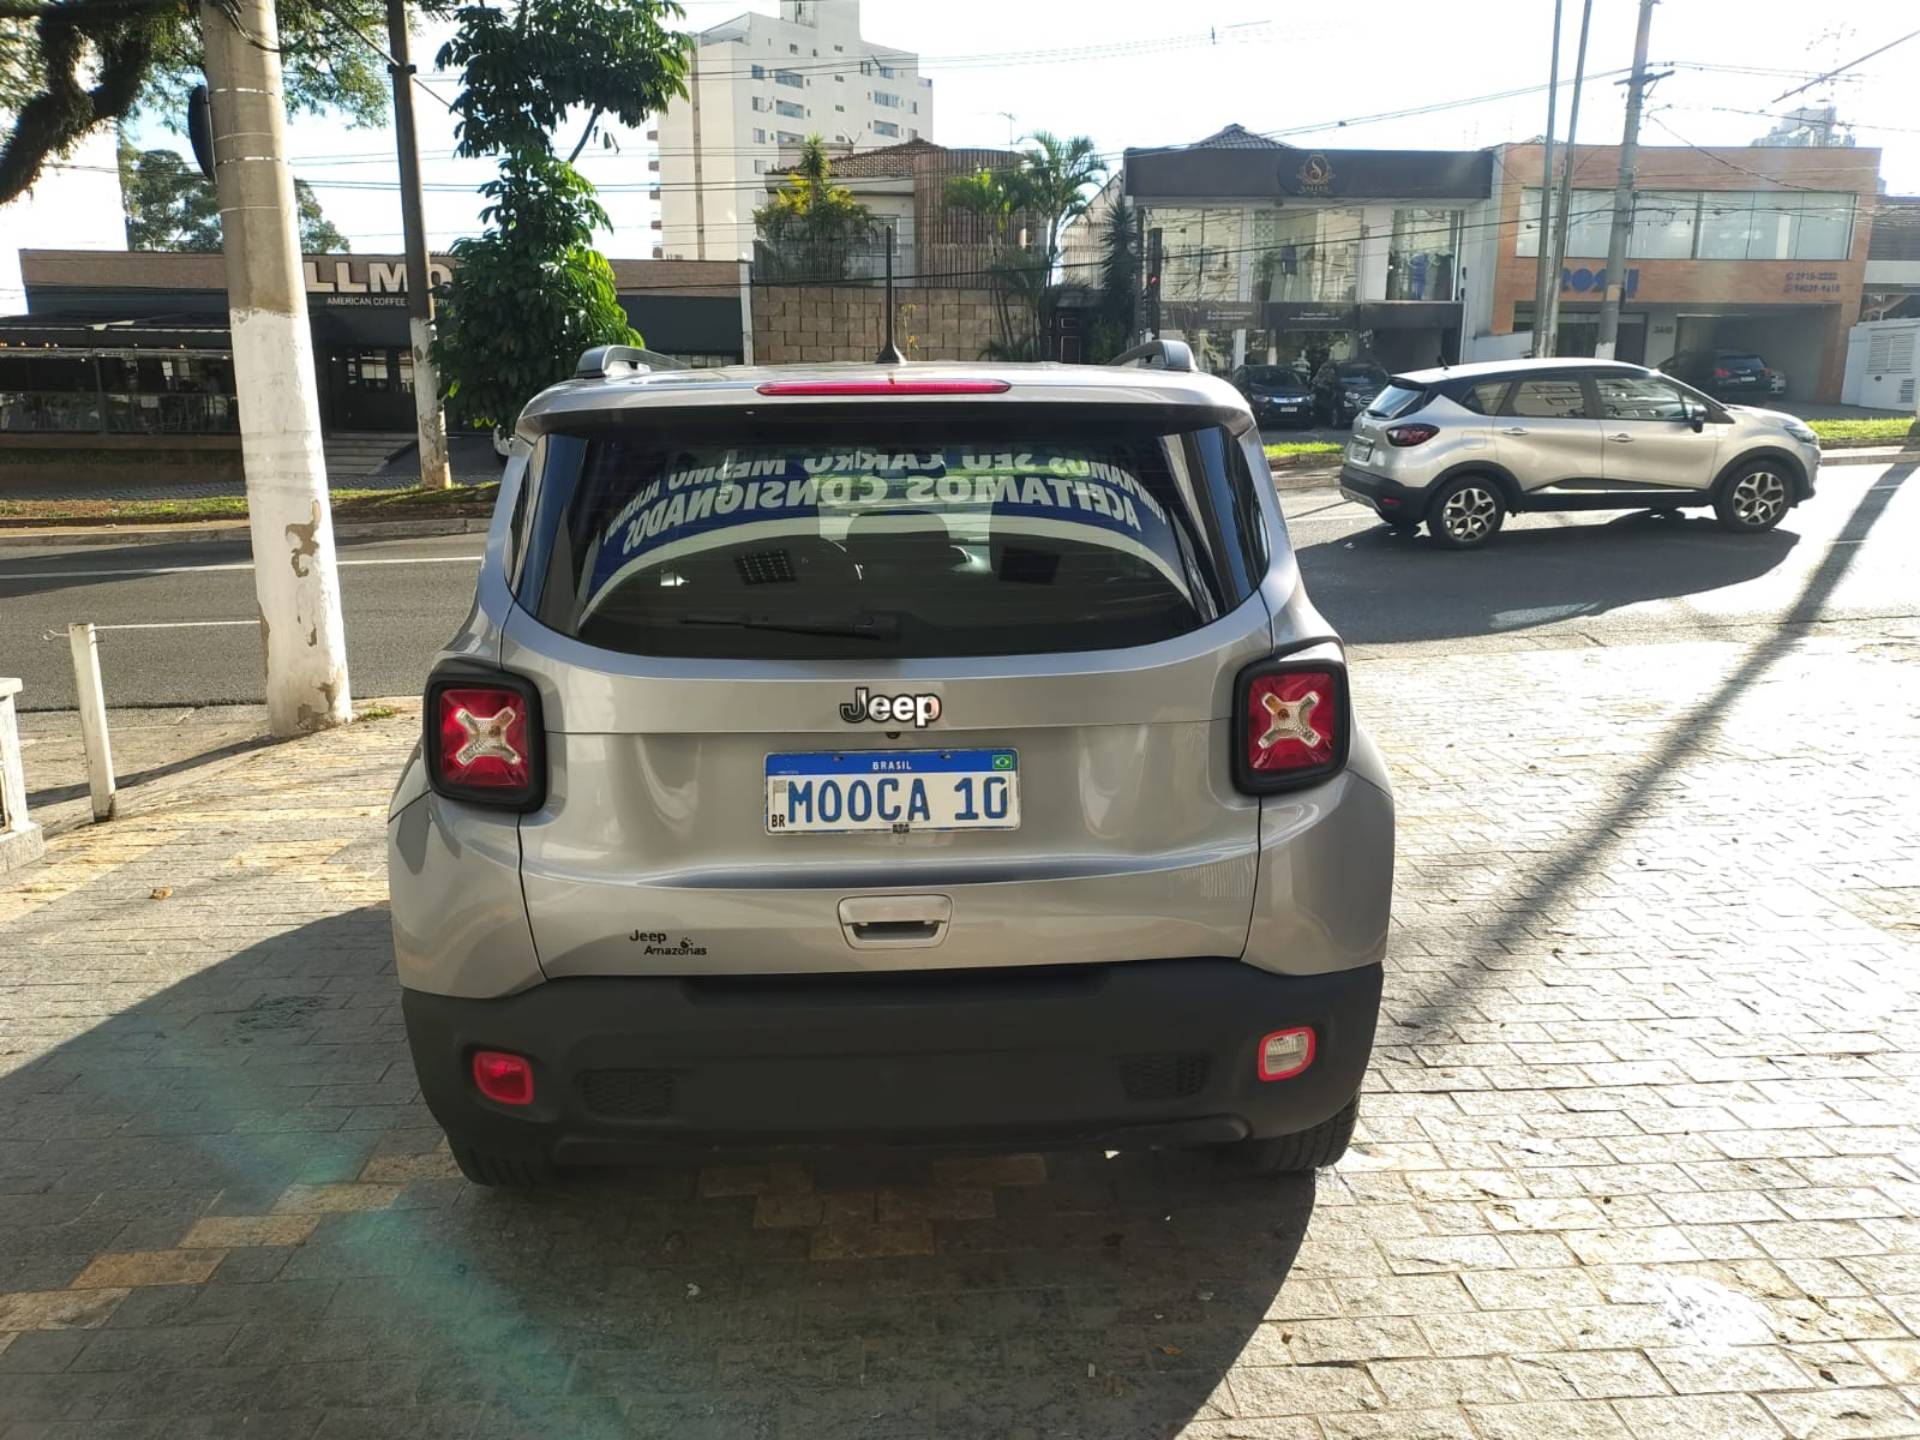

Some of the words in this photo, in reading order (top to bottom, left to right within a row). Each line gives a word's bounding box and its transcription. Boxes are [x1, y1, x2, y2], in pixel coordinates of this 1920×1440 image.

[326, 296, 372, 306] AMERICAN
[373, 297, 406, 307] COFFEE
[840, 686, 943, 728] Jeep
[872, 760, 912, 771] BRASIL
[788, 778, 931, 824] MOOCA
[953, 776, 1008, 821] 10
[771, 813, 786, 828] BR
[629, 929, 667, 945] Jeep
[643, 945, 708, 956] Amazonas
